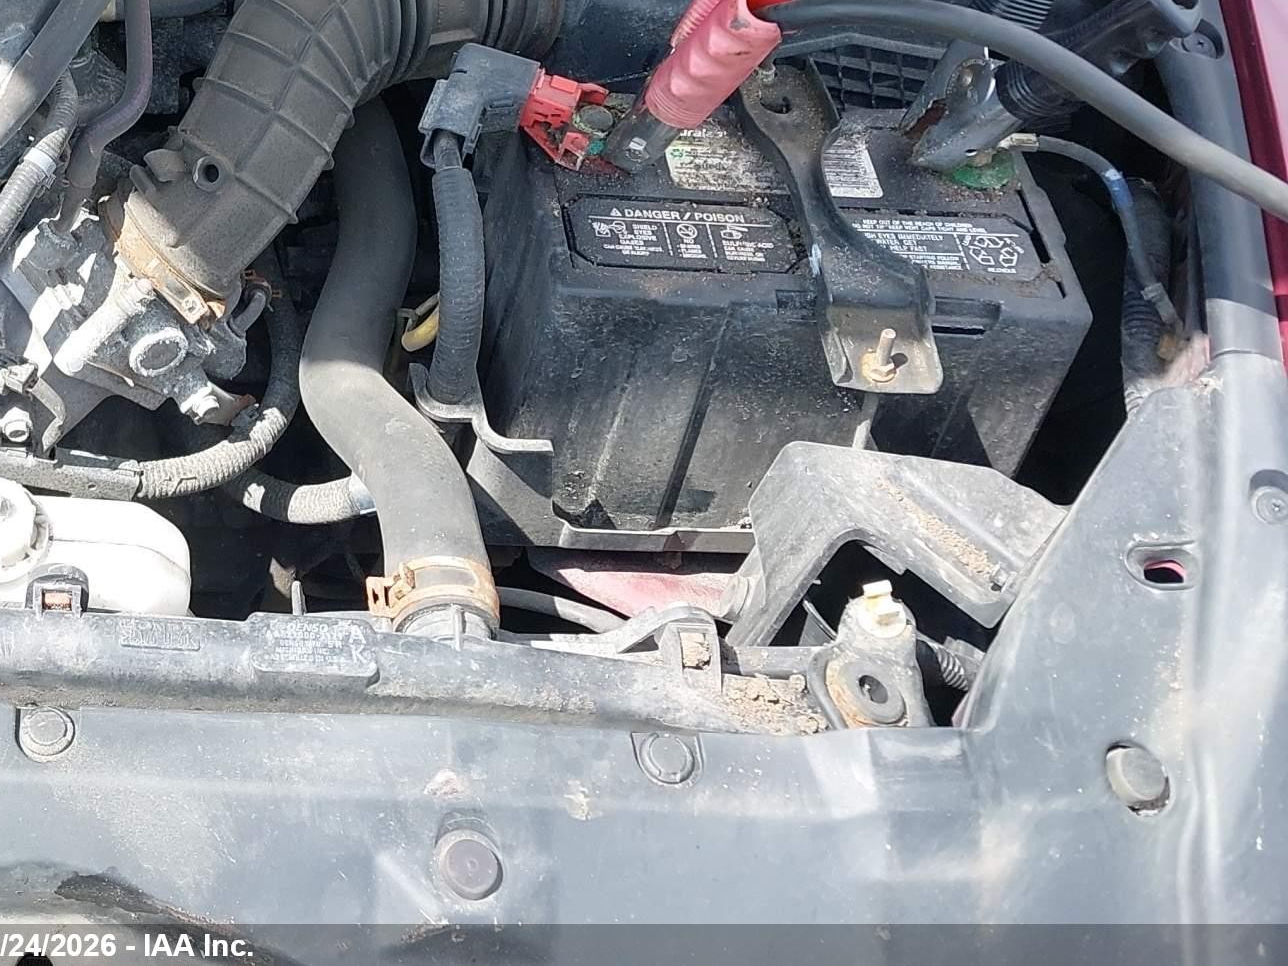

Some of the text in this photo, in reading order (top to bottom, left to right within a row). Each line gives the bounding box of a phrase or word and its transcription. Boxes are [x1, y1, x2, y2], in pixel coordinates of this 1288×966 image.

[624, 209, 744, 222] DANGER / POISON
[287, 623, 329, 633] DENSO
